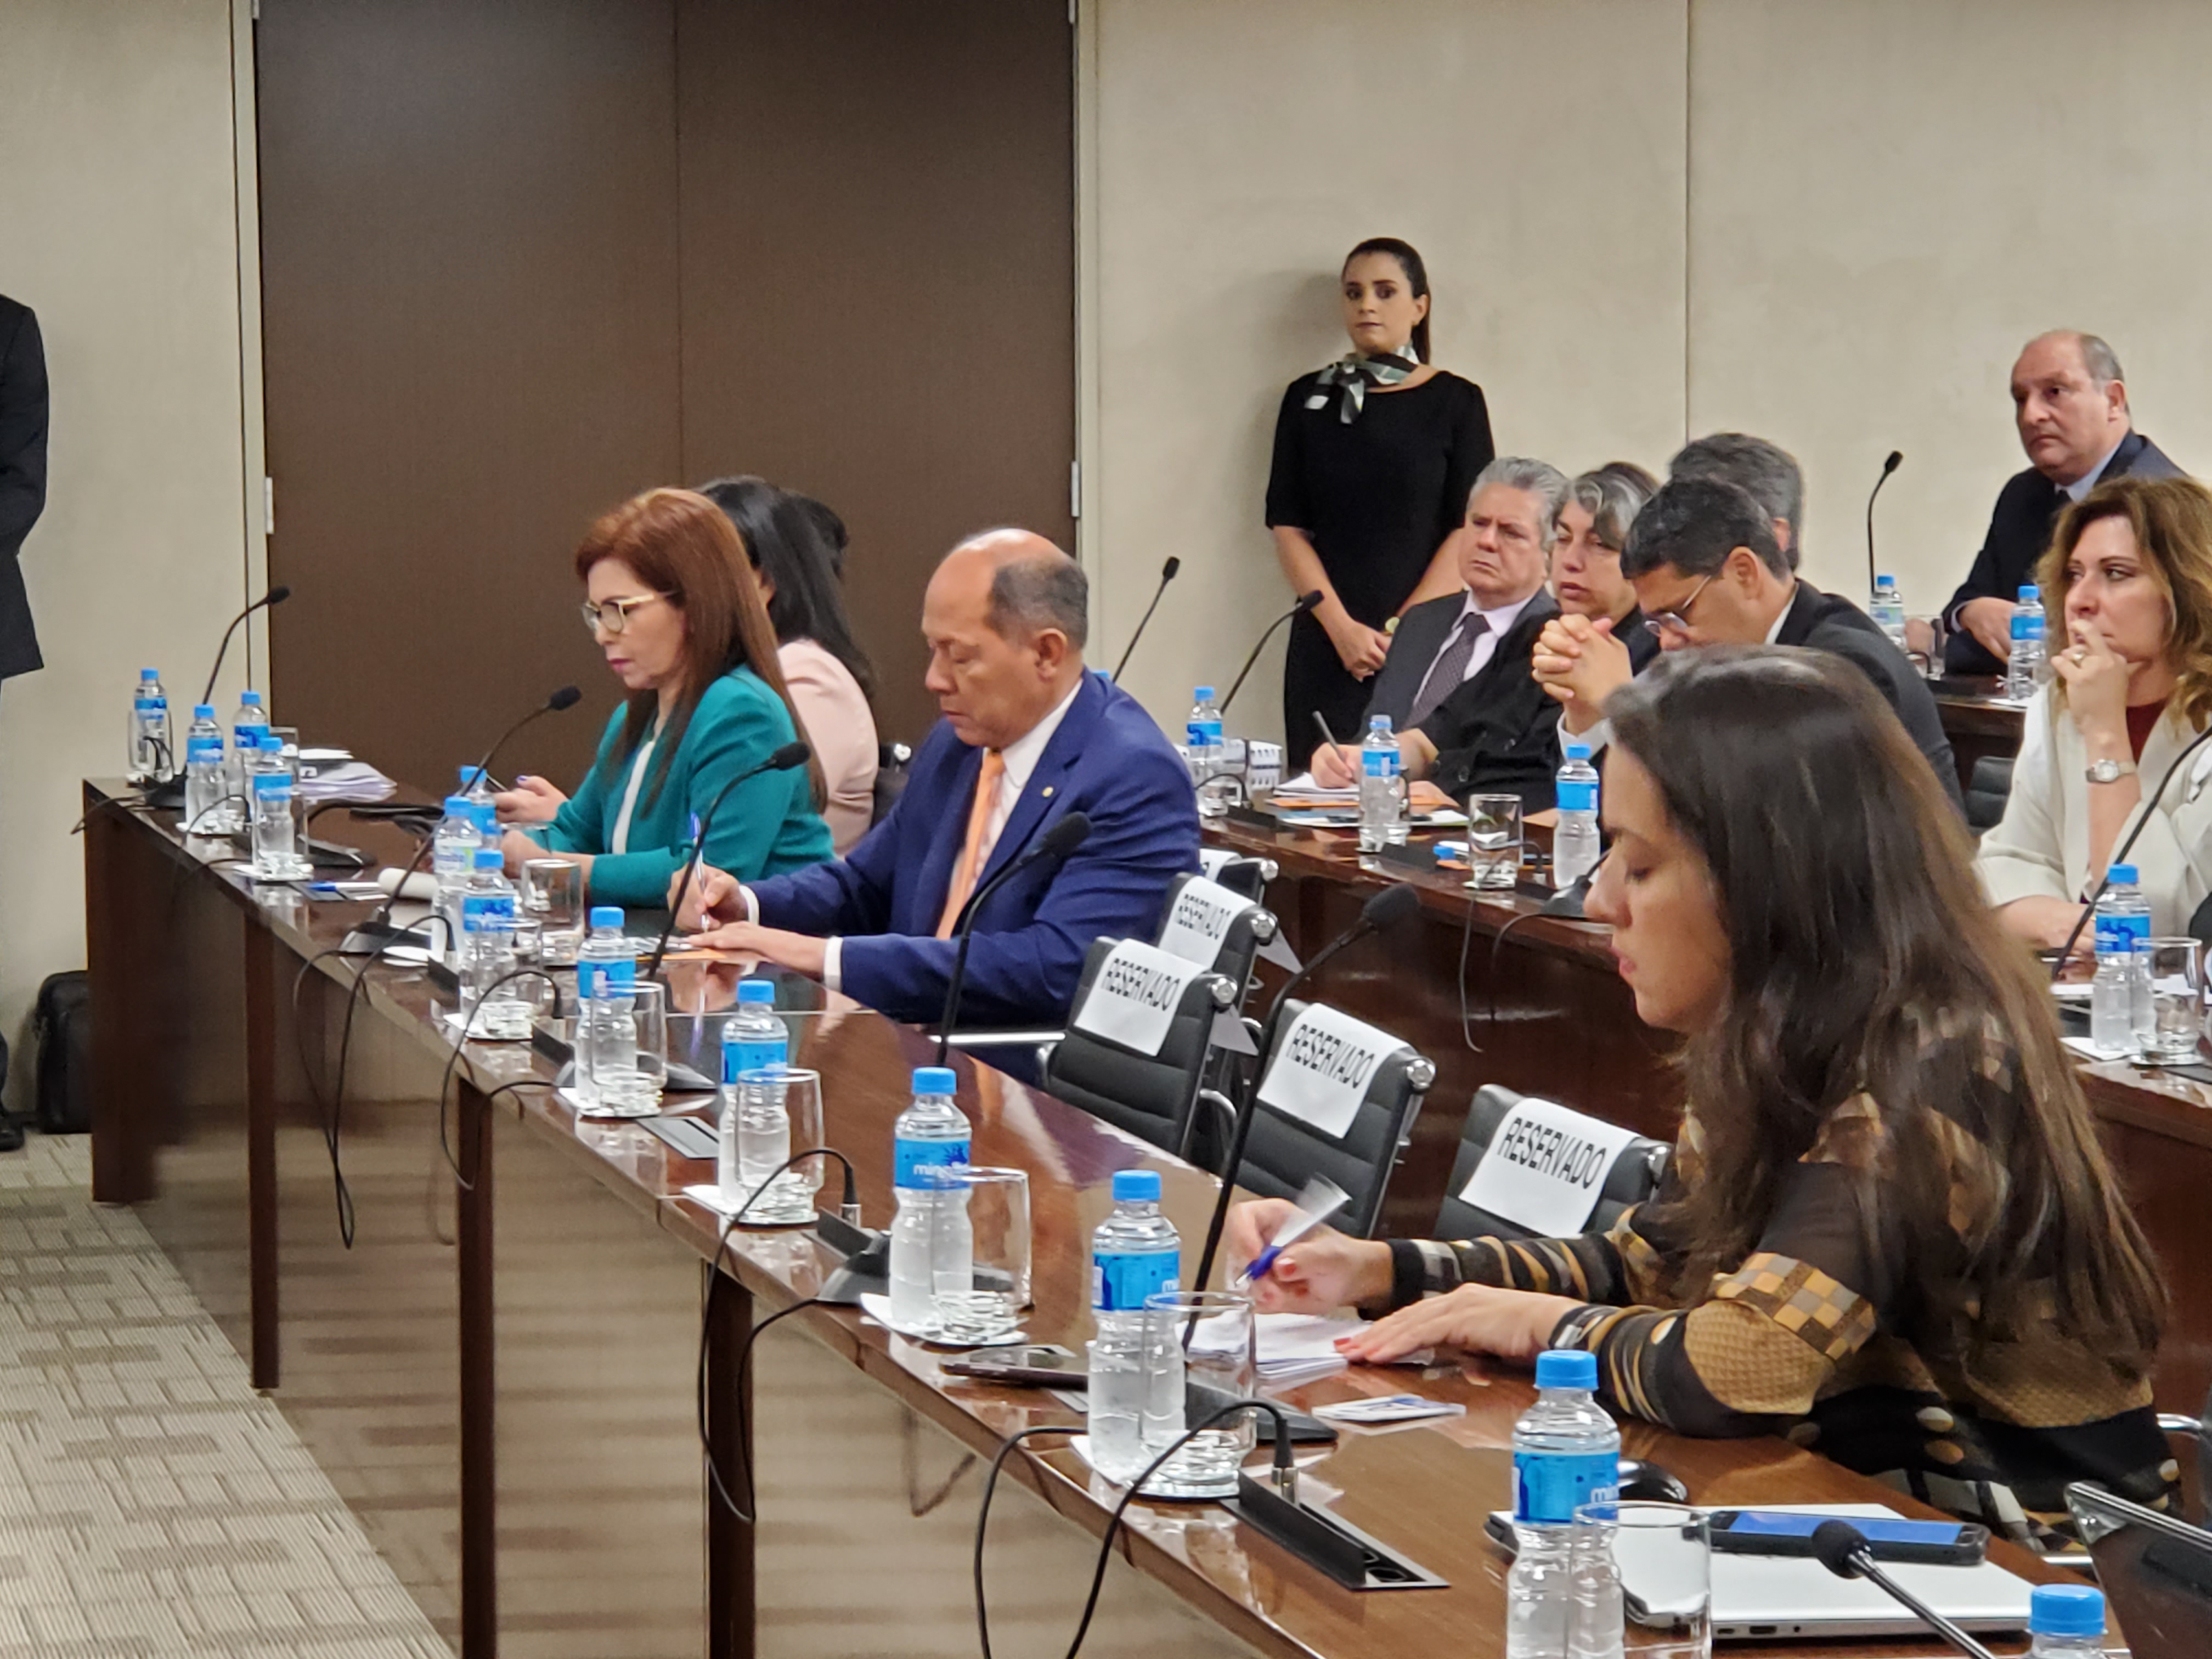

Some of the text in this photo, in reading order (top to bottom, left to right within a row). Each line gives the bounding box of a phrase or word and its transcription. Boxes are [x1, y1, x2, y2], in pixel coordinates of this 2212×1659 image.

[1101, 958, 1181, 1011] RESERVADO
[1286, 1024, 1374, 1088] RESERVADO
[1497, 1116, 1606, 1189] RESERVADO
